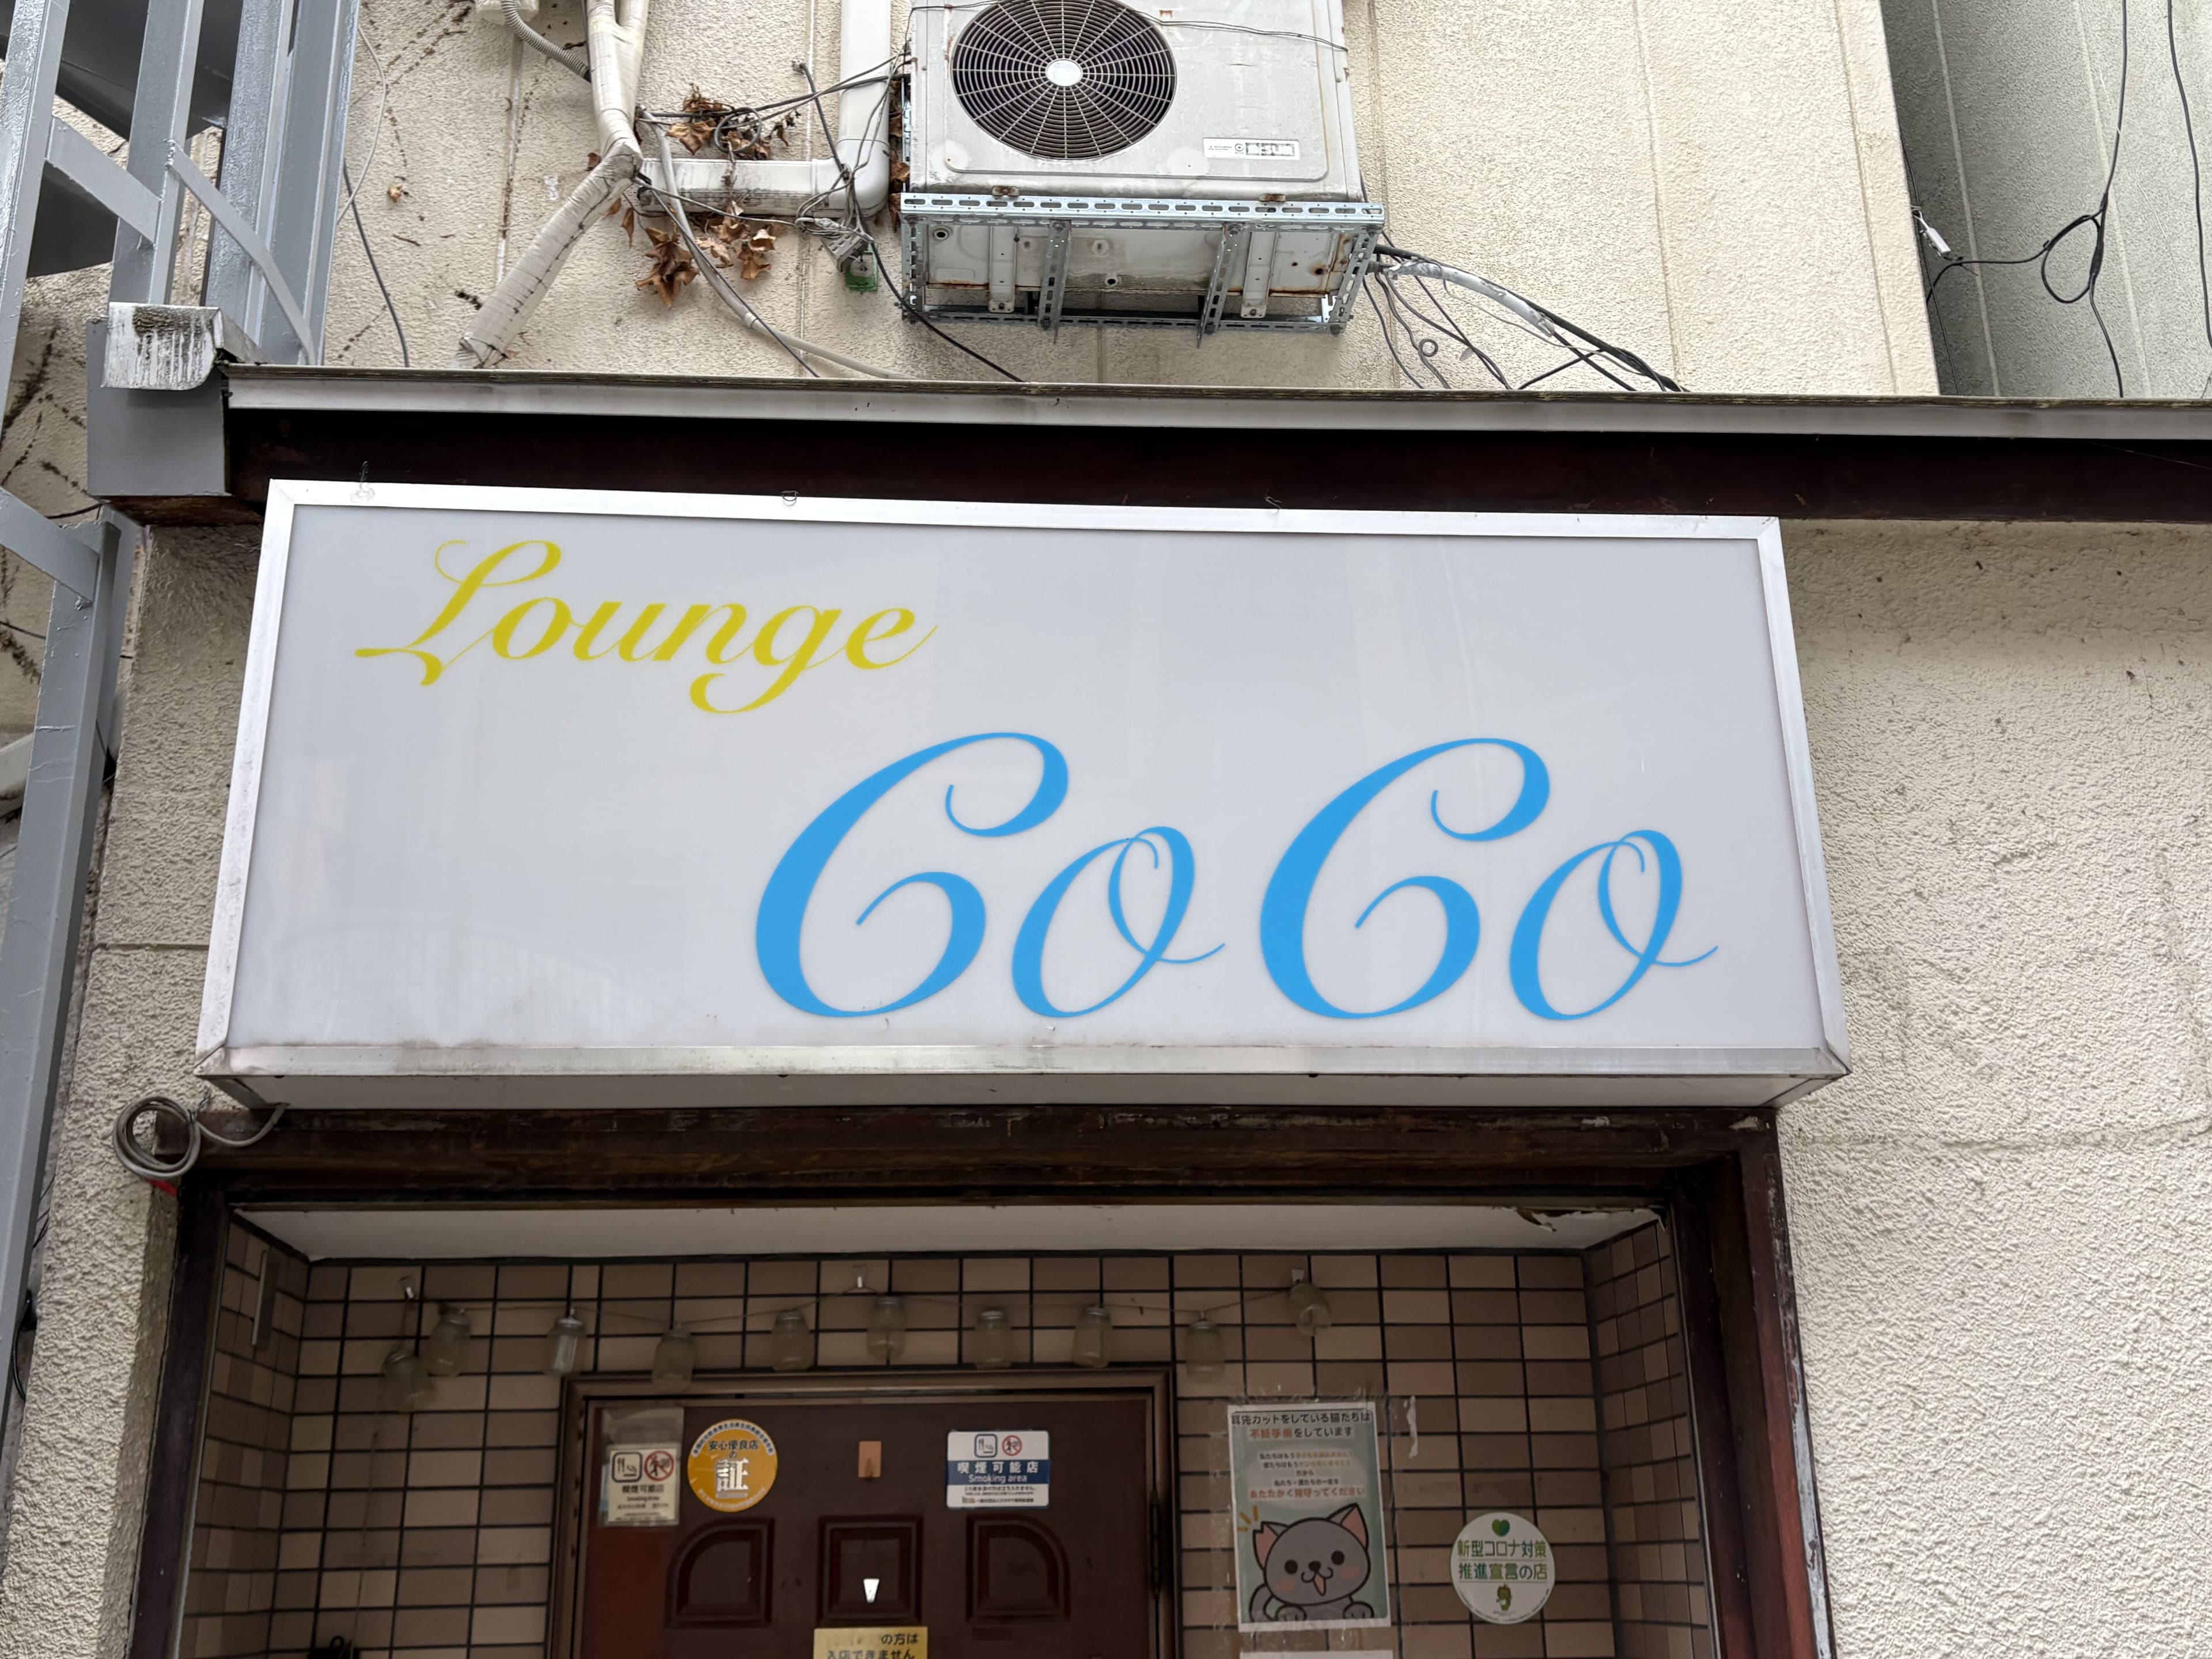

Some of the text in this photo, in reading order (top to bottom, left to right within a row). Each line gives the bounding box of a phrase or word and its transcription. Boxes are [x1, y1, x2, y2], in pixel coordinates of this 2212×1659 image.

[355, 540, 938, 714] Lounge
[709, 1440, 759, 1450] 安心優良店
[716, 1458, 749, 1491] 証
[957, 1461, 1039, 1474] 喫煙可能店
[968, 1474, 1006, 1484] Smoking
[1457, 1539, 1547, 1558] 新型コロナ対策
[1459, 1562, 1548, 1580] 推進宣言の店
[881, 1633, 919, 1646] の方は
